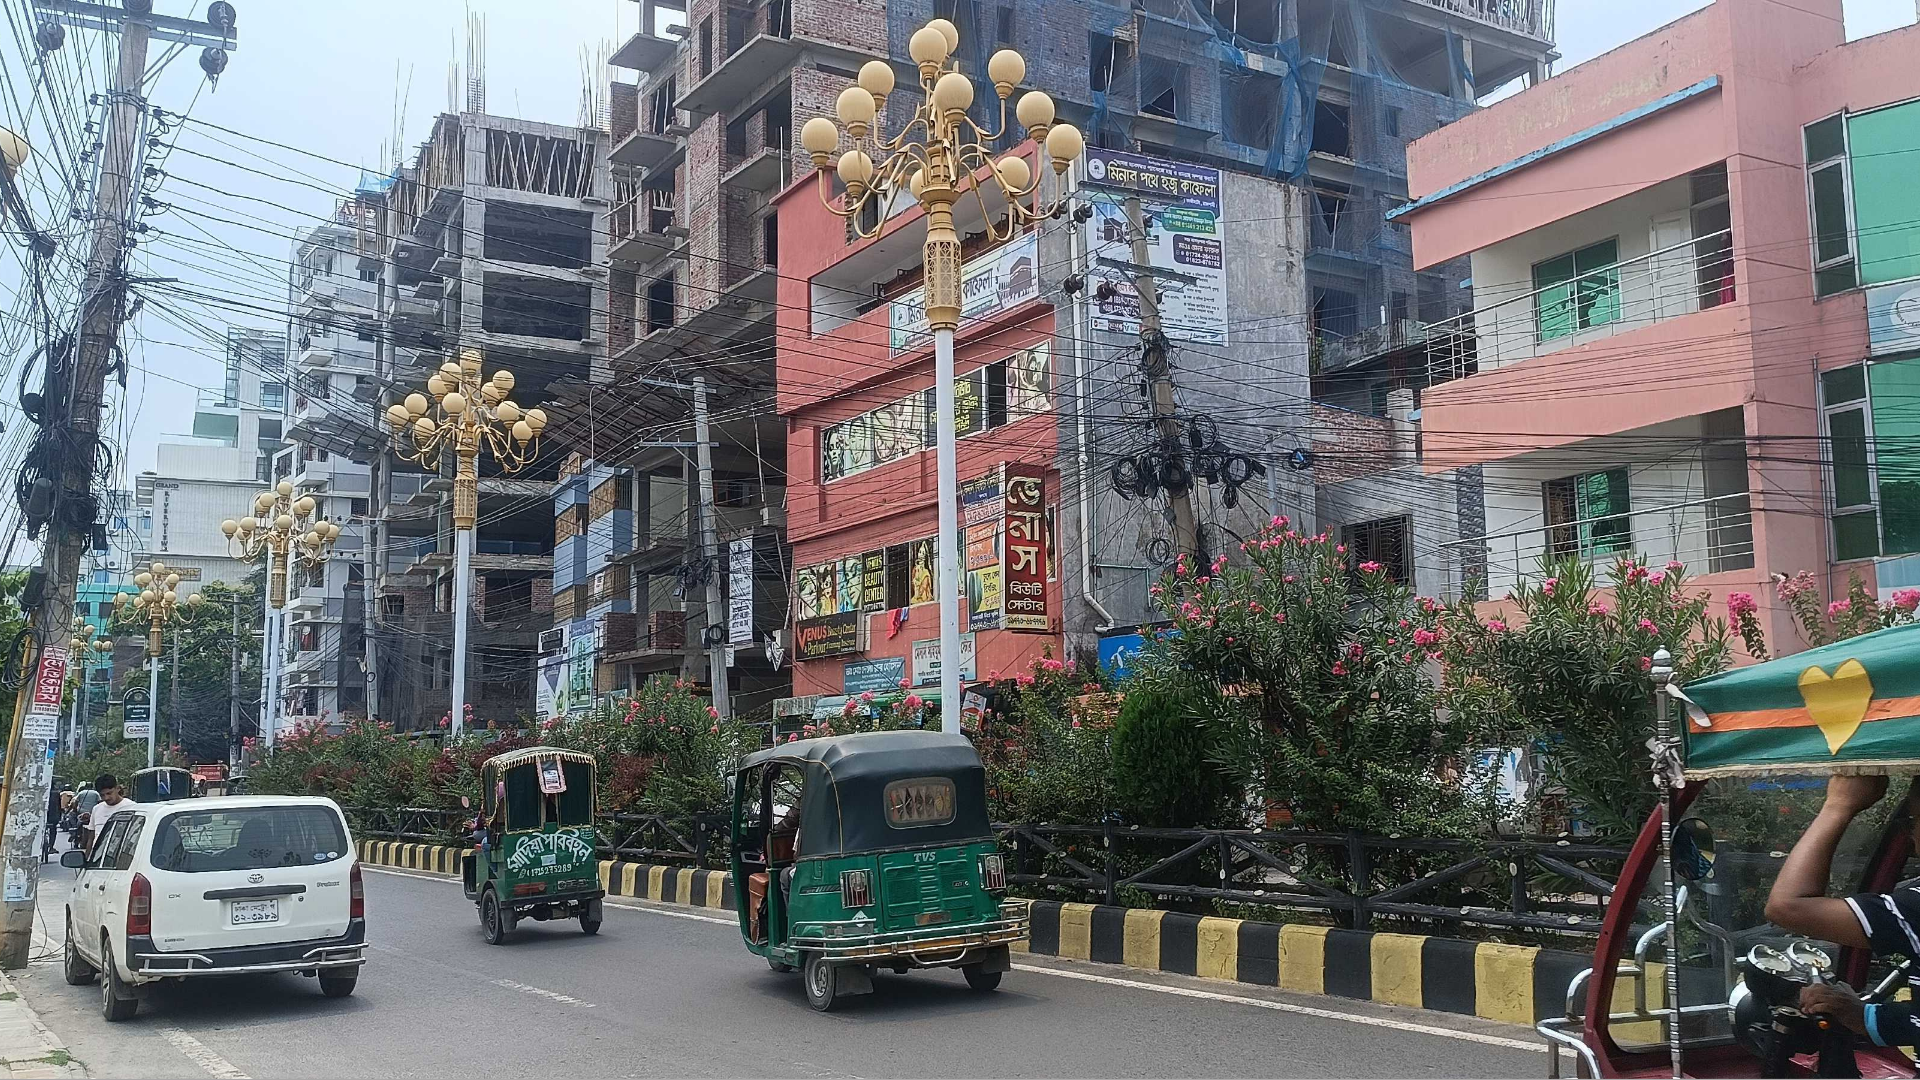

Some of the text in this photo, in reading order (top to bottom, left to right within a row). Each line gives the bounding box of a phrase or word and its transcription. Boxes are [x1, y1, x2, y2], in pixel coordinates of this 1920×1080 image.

[1140, 173, 1159, 188] পথে
[1161, 175, 1178, 195] হজ্ব
[1180, 179, 1217, 198] কাফেলা
[962, 267, 994, 299] কাফেলা
[864, 570, 884, 587] BEAUTY
[864, 587, 884, 602] CENTER
[1009, 580, 1043, 595] বিউটি
[1007, 598, 1045, 612] সেন্টার
[797, 621, 827, 653] VENUS
[913, 851, 936, 863] TVS
